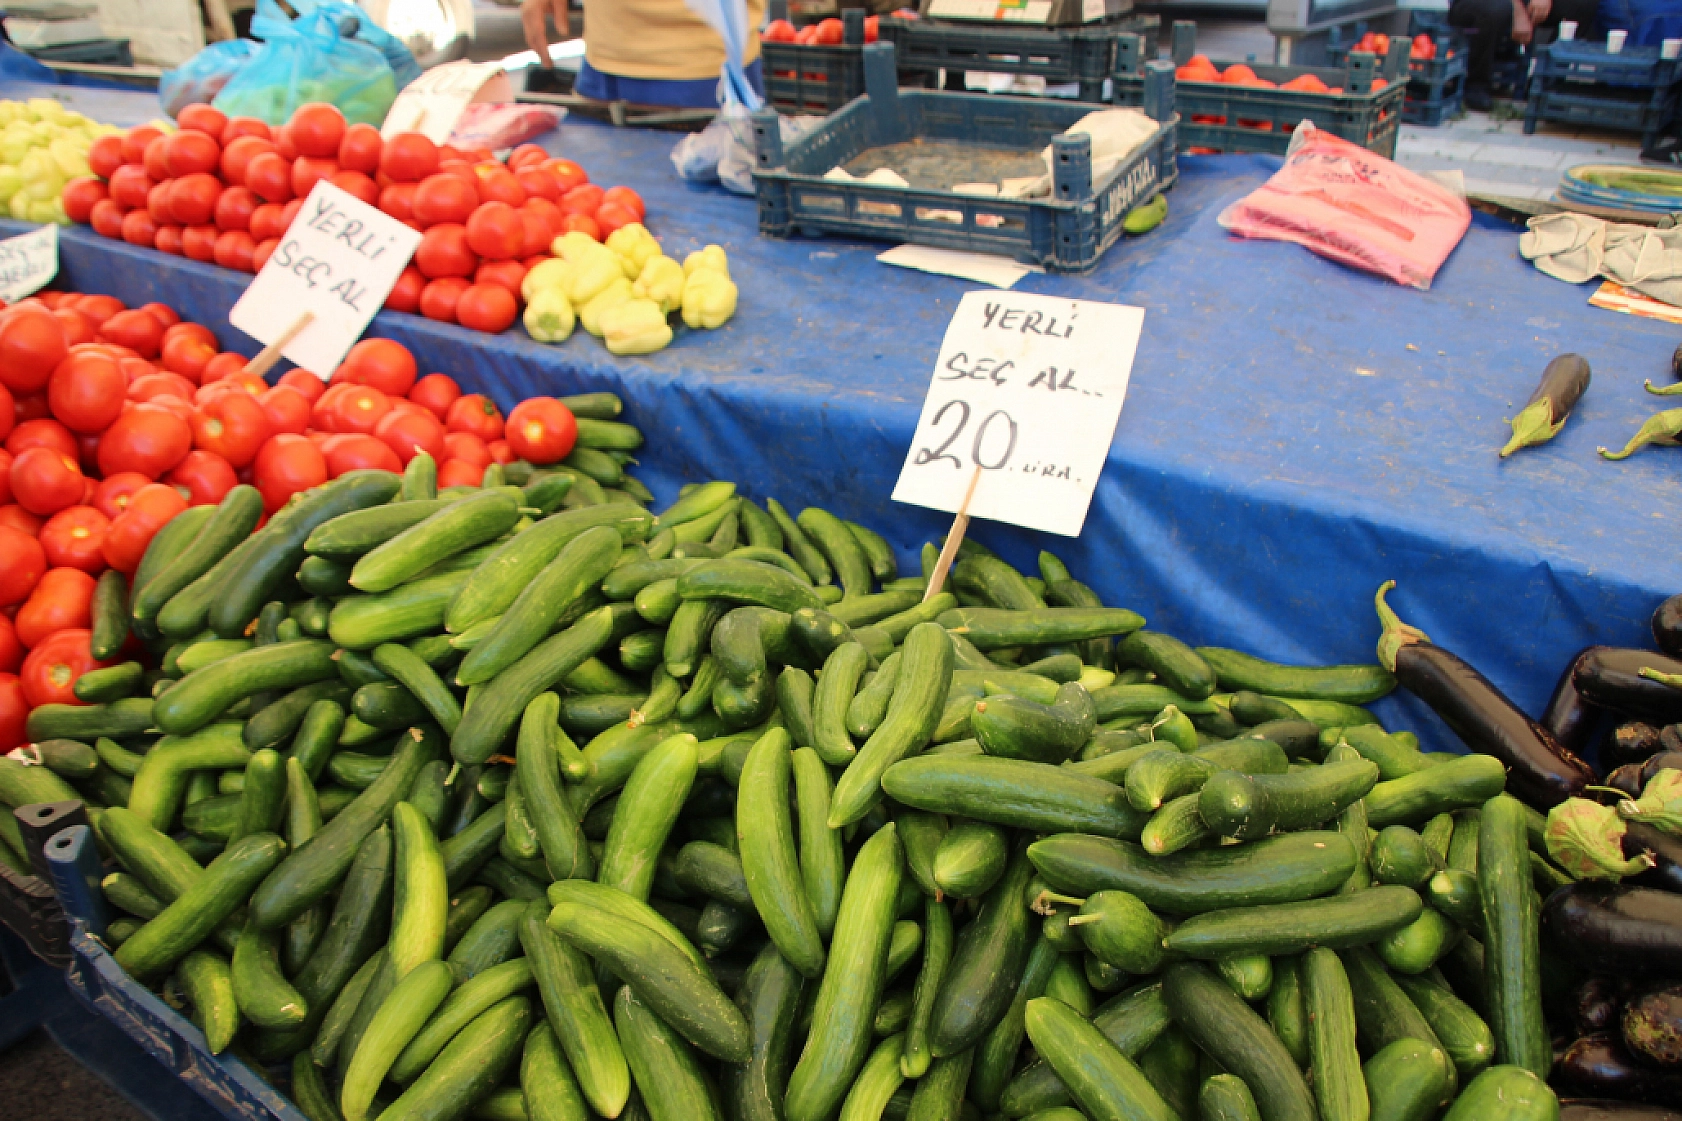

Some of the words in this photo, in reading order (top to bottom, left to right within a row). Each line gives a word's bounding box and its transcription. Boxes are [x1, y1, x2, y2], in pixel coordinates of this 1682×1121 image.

[273, 239, 331, 289] SEÇ
[329, 277, 367, 312] AL
[938, 351, 1015, 386] SEÇ
